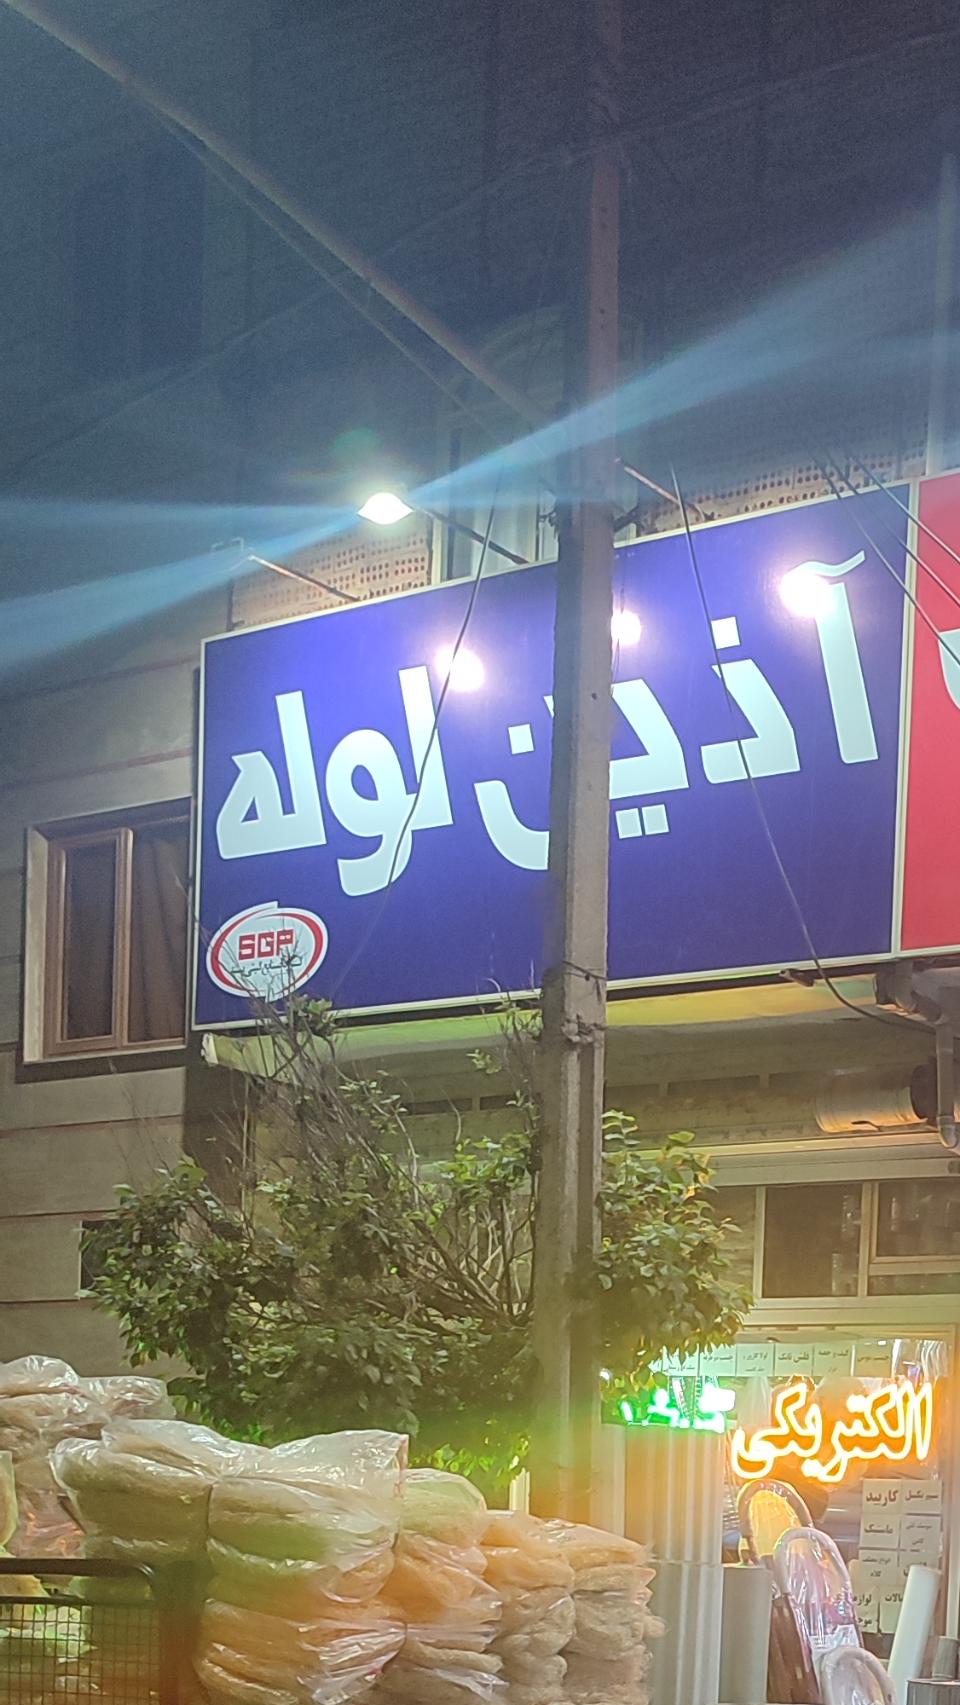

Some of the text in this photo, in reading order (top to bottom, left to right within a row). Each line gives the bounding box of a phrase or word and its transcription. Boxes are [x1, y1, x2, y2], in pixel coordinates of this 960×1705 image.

[474, 550, 878, 870] آذین
[216, 666, 454, 896] لوله
[239, 930, 294, 961] SGP
[731, 1380, 934, 1482] الکتریکی
[866, 1489, 899, 1506] کاربید
